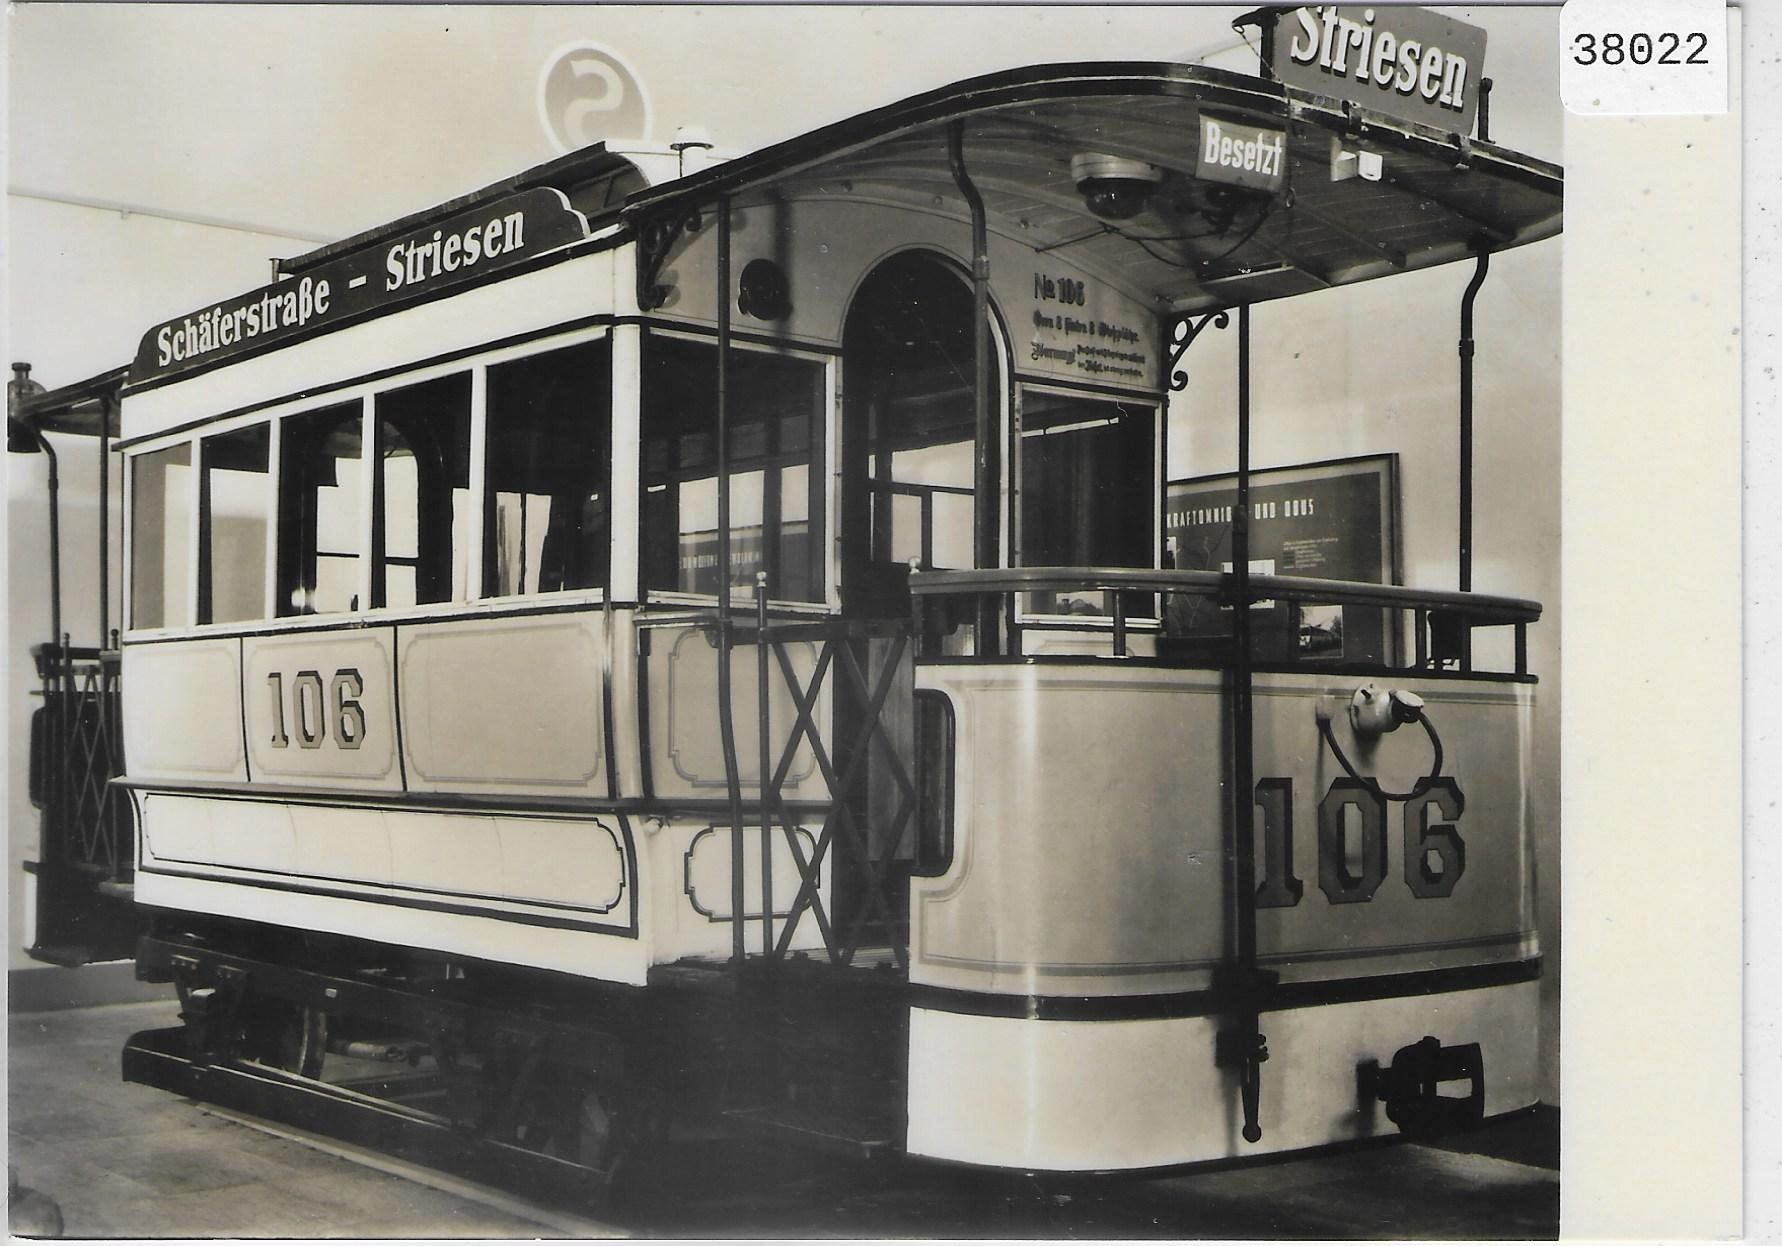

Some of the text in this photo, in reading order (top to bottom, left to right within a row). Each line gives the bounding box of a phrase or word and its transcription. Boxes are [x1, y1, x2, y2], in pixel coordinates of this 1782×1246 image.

[1290, 6, 1468, 110] Striesen
[1574, 32, 1709, 65] 38022
[1204, 120, 1283, 177] Besetzt
[157, 276, 331, 368] Schäferstraße
[385, 209, 525, 293] Striesen
[1057, 277, 1086, 307] 106
[1254, 502, 1276, 520] UND
[267, 668, 367, 750] 106
[1254, 777, 1466, 909] 106
